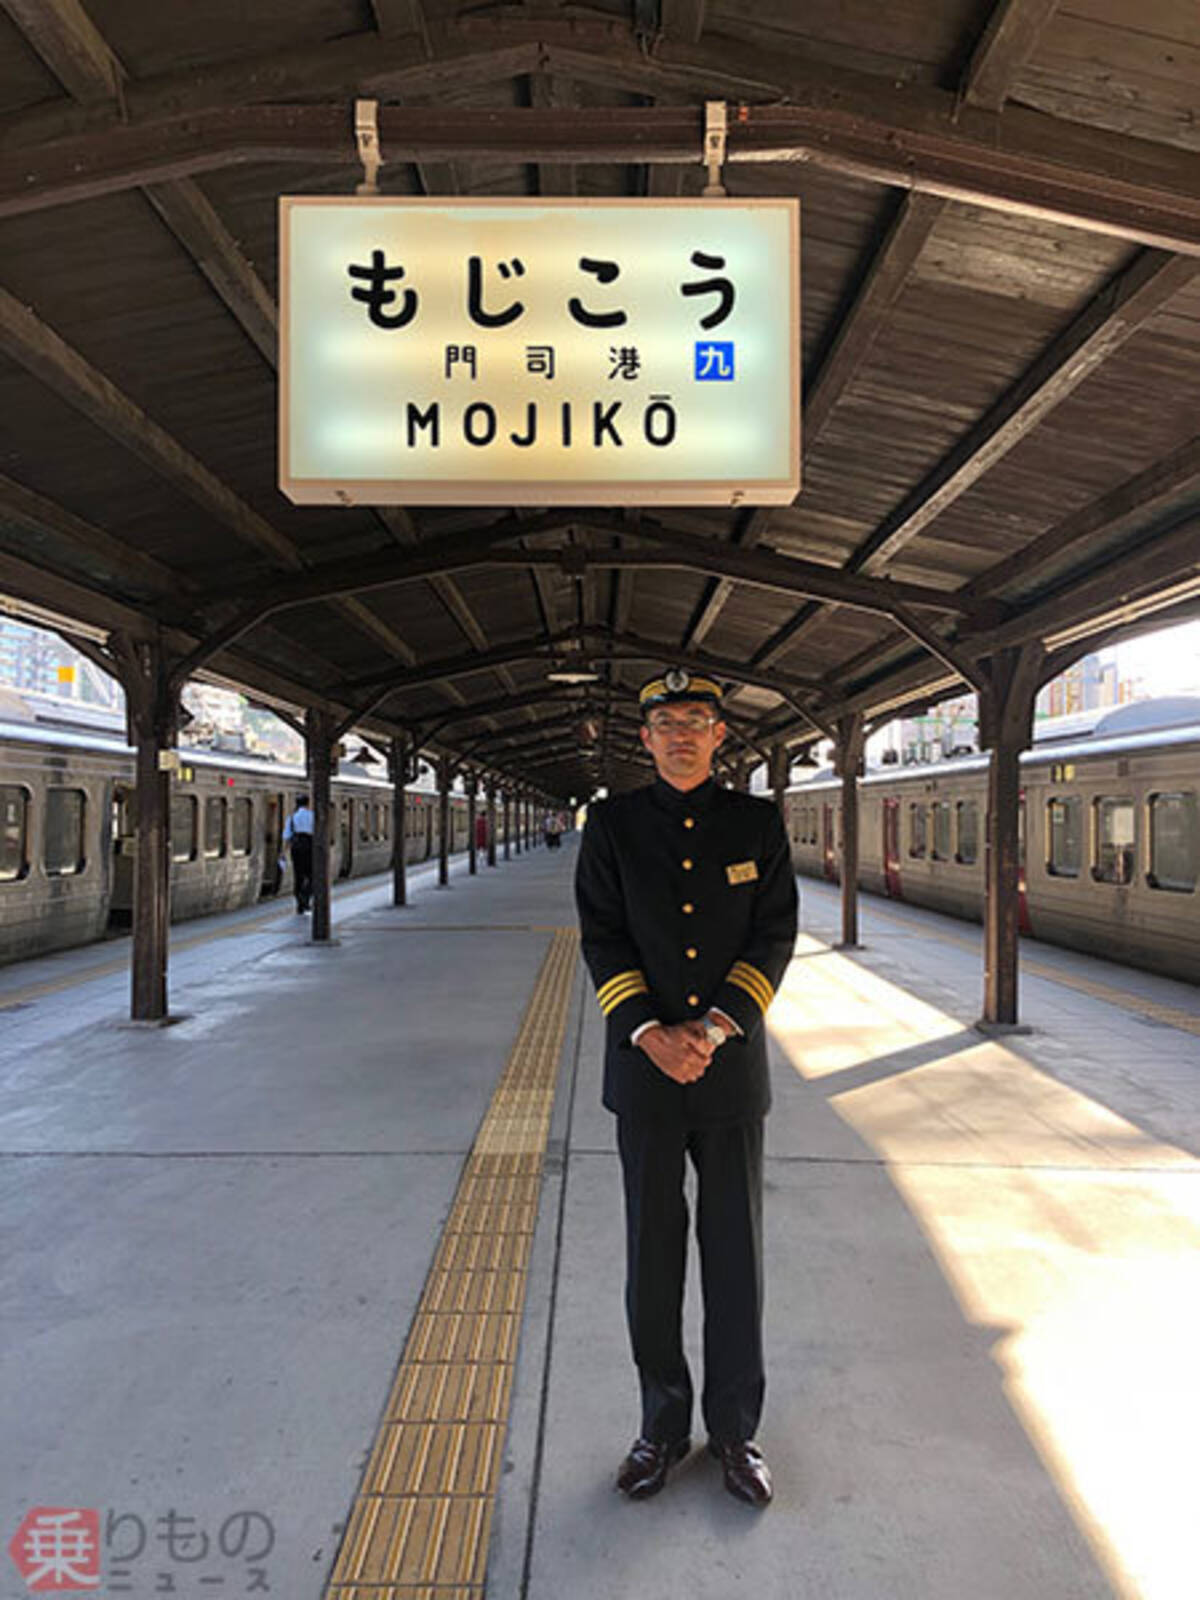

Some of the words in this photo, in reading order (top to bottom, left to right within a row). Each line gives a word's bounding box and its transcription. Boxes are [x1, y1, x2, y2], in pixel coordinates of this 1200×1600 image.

[348, 250, 735, 330] もじこう
[445, 345, 641, 380] 門司港
[697, 345, 733, 379] 九
[406, 394, 677, 447] MOJIKŌ
